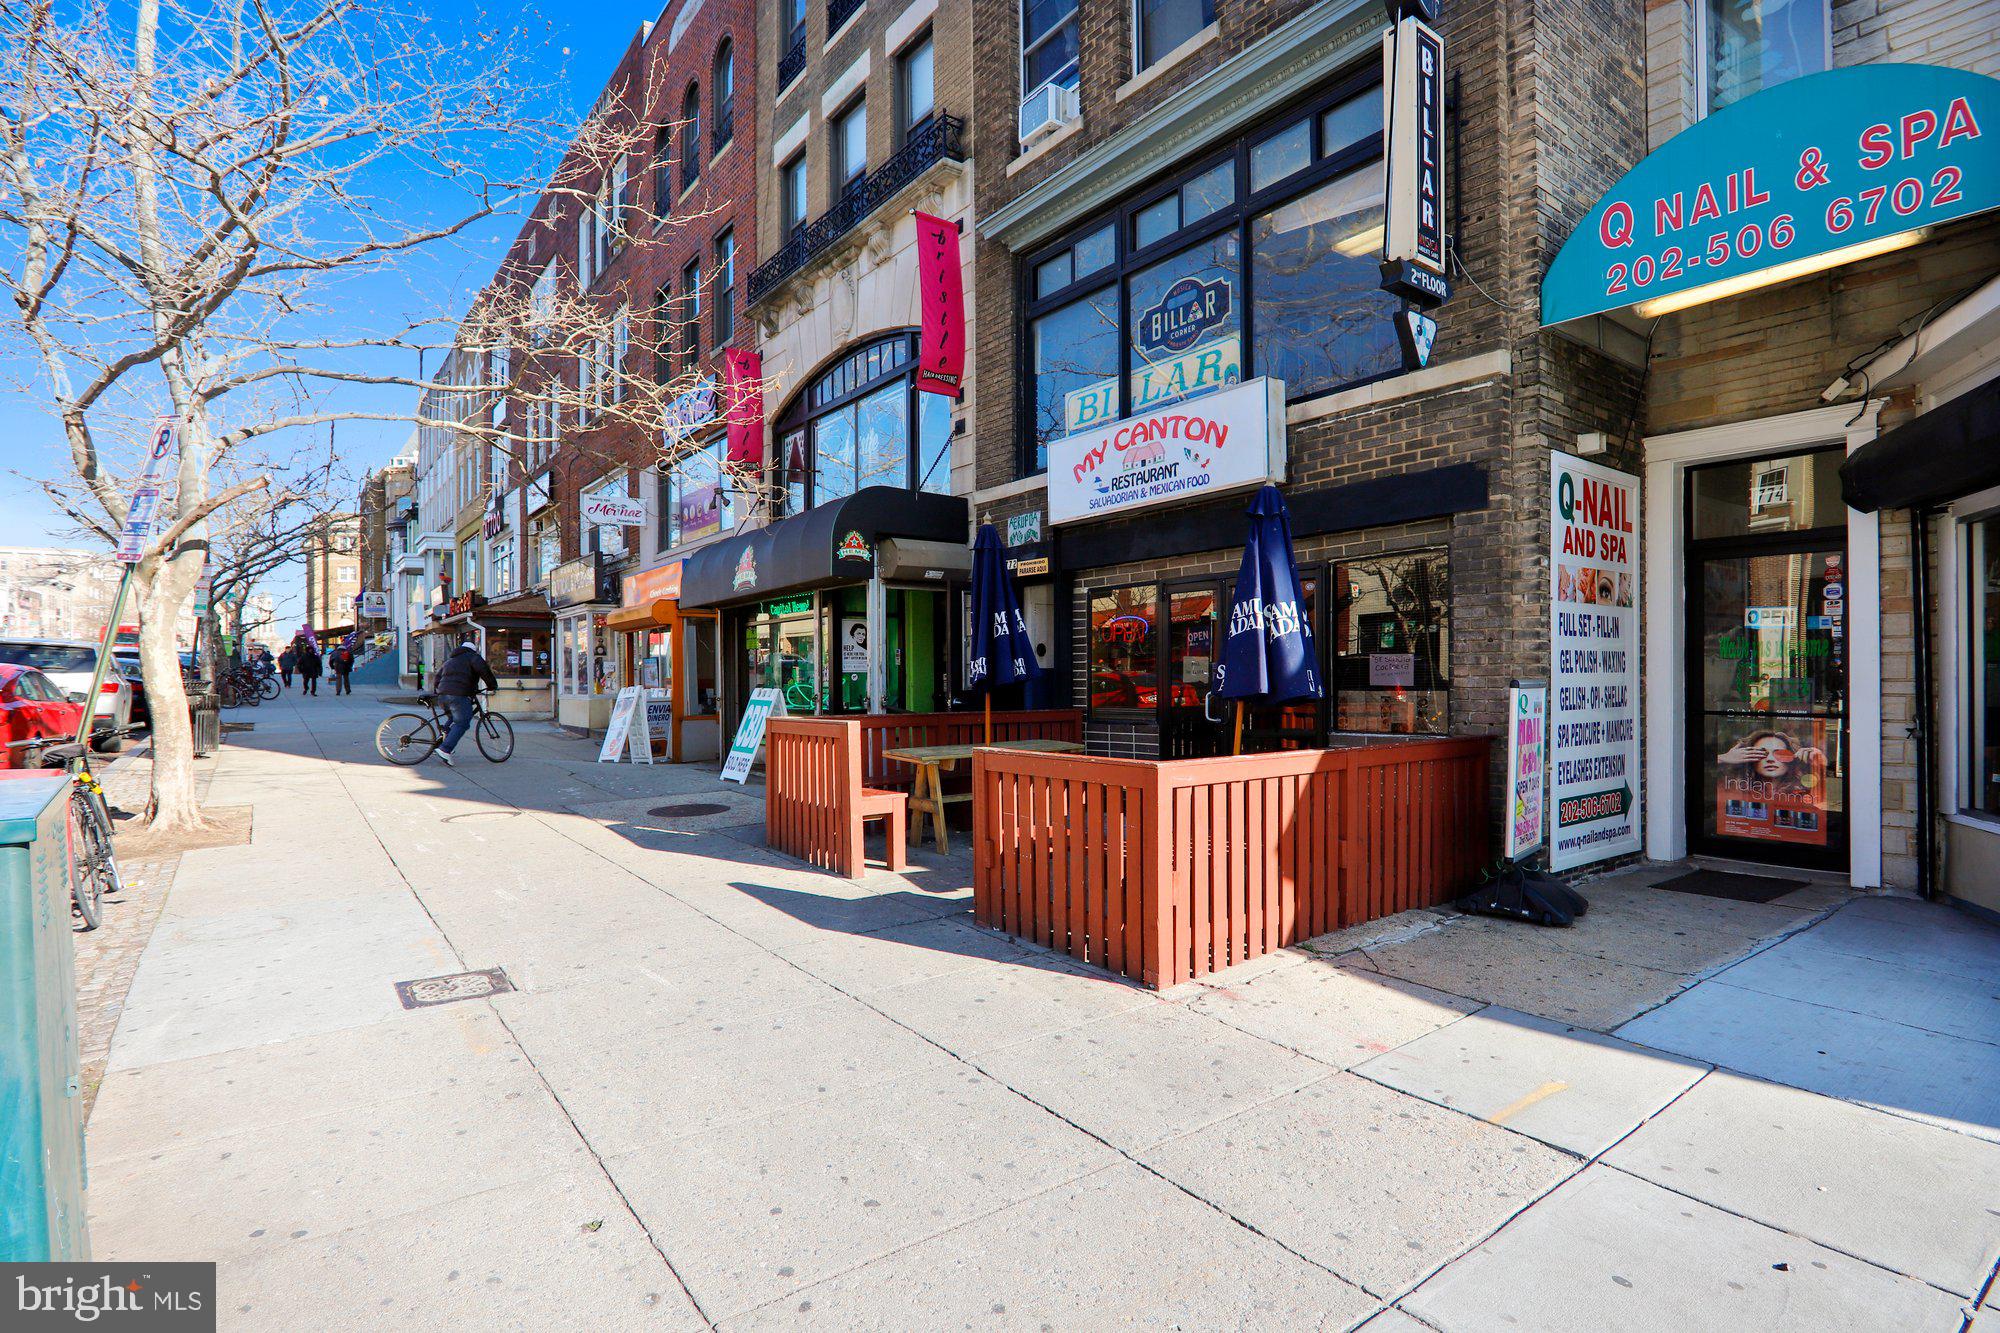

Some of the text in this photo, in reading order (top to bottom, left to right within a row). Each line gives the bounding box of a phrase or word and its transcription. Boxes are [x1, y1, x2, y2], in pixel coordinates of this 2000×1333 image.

[1421, 45, 1435, 230] BILLAR
[1600, 96, 1982, 249] Q NAIL & SPA
[1605, 165, 1964, 297] 202-506 6702
[932, 229, 949, 369] bristle
[1421, 272, 1447, 298] FLOOR
[1151, 289, 1216, 342] BILLAR
[1170, 324, 1196, 339] CORNER
[1074, 349, 1224, 426] BILAR
[1073, 415, 1229, 484] MY CANTON
[1089, 473, 1211, 510] SALVADORIAN & MEXICAN FOOD
[1111, 462, 1180, 492] RESTAURANT
[1558, 471, 1633, 533] Q-NAIL
[1563, 525, 1627, 564] AND SPA
[1019, 566, 1037, 574] PARARSE
[1101, 620, 1146, 643] OPEN
[1558, 612, 1577, 637] FULL
[1578, 613, 1592, 638] SET
[1596, 615, 1620, 639] FILL-IN
[1747, 609, 1797, 625] OPEN
[1187, 630, 1209, 642] OPEN
[1560, 649, 1574, 674] GEL
[1574, 649, 1598, 674] POLISH
[1601, 650, 1626, 674] WAXING
[647, 704, 672, 714] ENVIA
[1519, 693, 1528, 715] Q
[1560, 686, 1586, 711] GELLISH
[1590, 686, 1601, 709] OPI
[1604, 685, 1628, 708] SHELLAC
[647, 713, 670, 722] DINERO
[735, 704, 769, 749] CBD
[1518, 718, 1541, 746] NAIL
[1557, 723, 1570, 749] SPA
[1570, 721, 1601, 748] PEDICURE
[1606, 718, 1633, 744] MANICURE
[1557, 753, 1626, 785] EYELASHES EXTENSION
[1725, 775, 1773, 792] Indian
[1561, 791, 1622, 824] 202-506-6702
[1558, 824, 1632, 852] www.q-nailandspa.com
